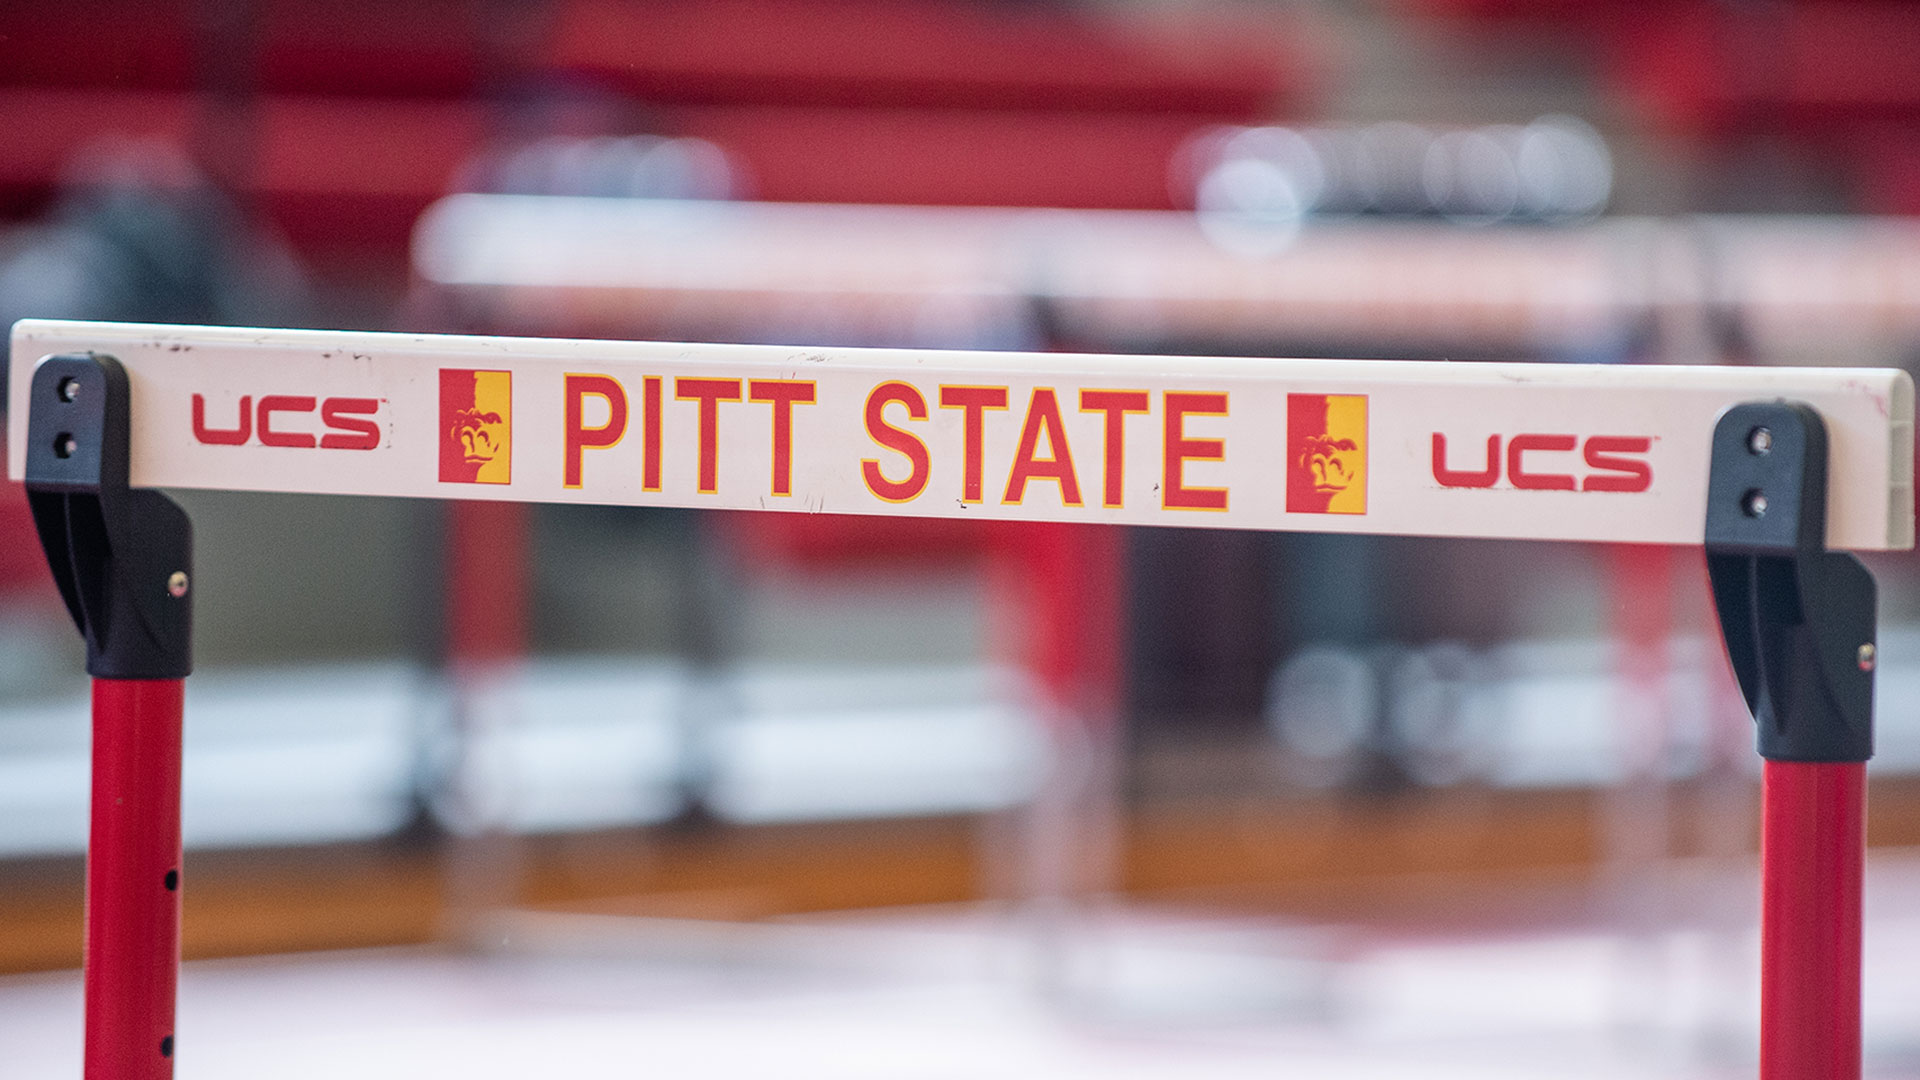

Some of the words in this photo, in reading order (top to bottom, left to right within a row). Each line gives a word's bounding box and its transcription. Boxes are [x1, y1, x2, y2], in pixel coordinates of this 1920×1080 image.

[192, 393, 381, 450] UCS
[562, 373, 817, 497] PITT
[860, 380, 1230, 512] STATE
[1431, 432, 1653, 493] UCS
